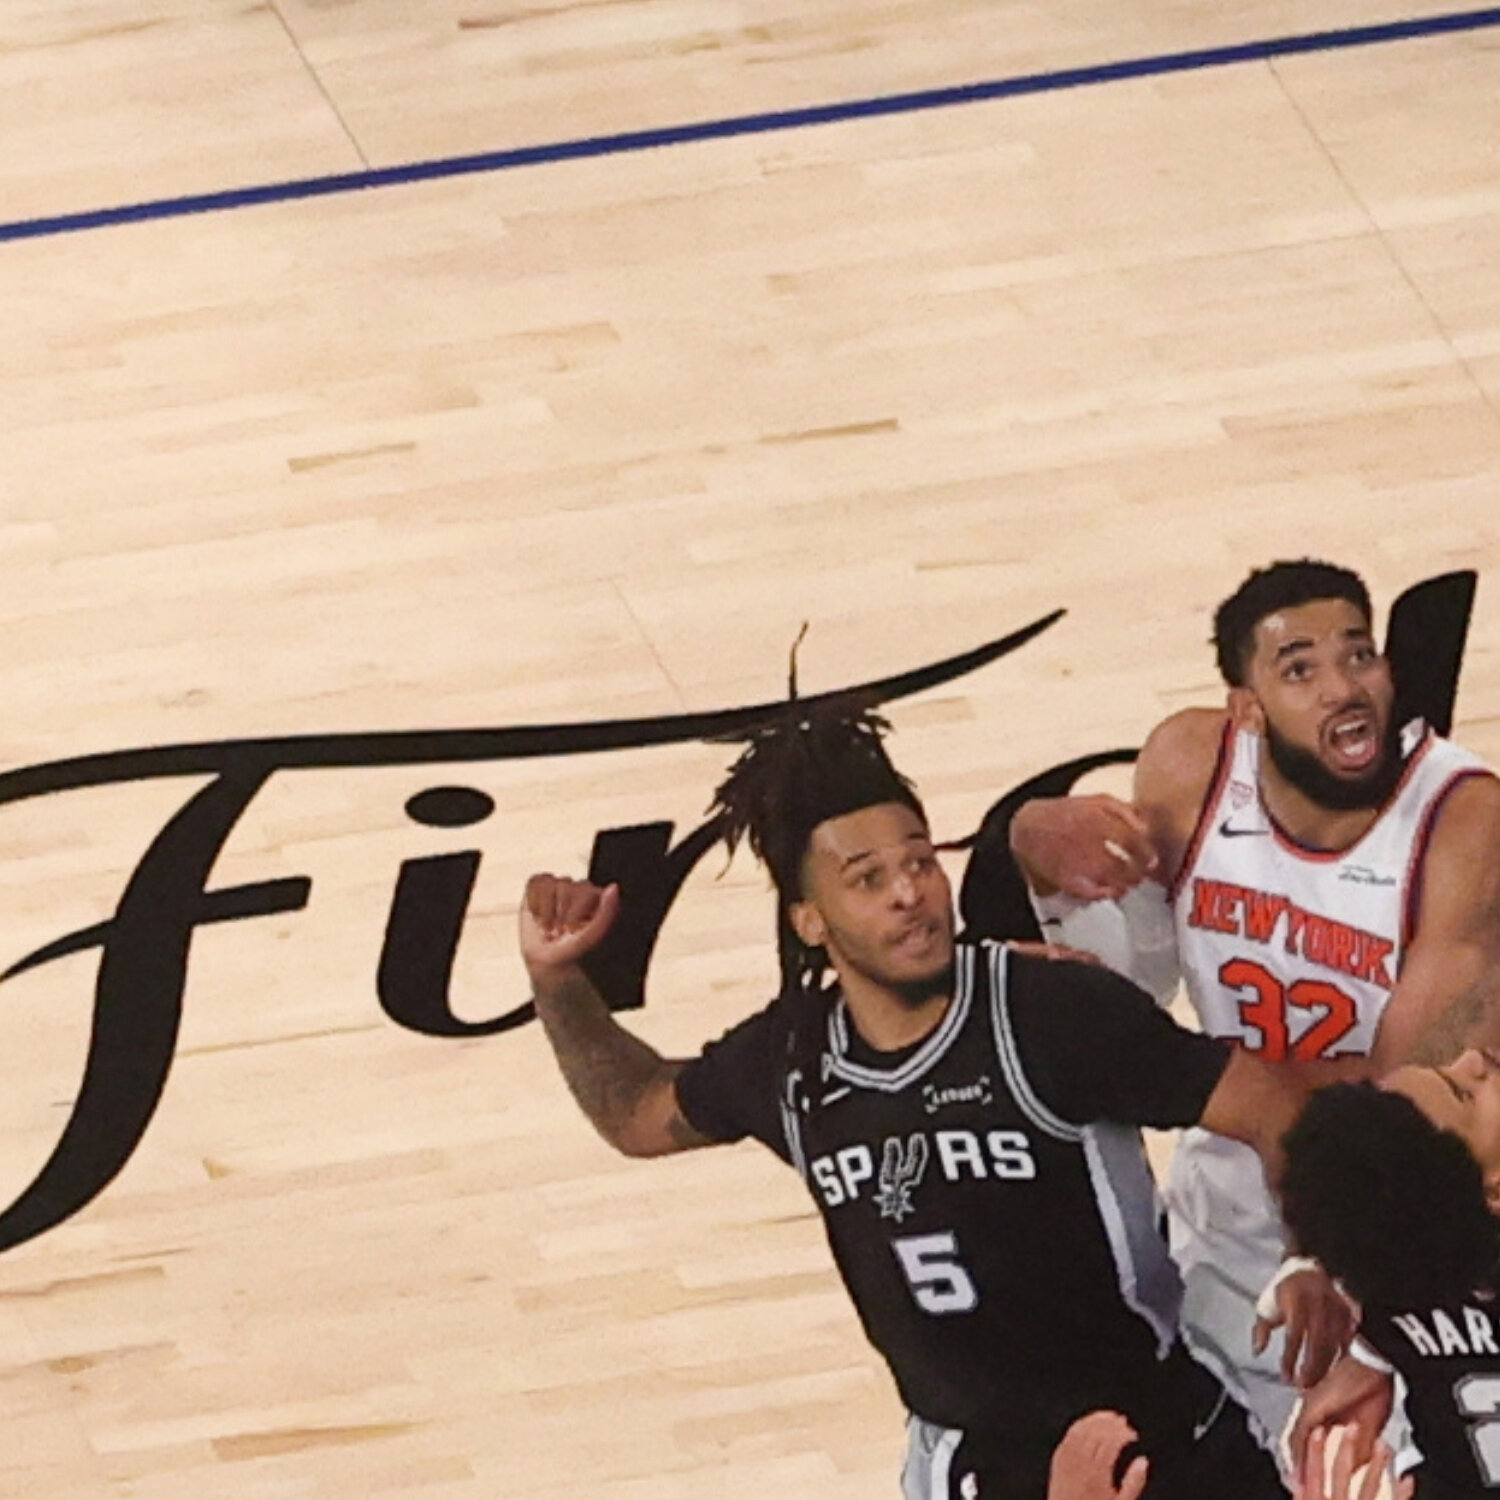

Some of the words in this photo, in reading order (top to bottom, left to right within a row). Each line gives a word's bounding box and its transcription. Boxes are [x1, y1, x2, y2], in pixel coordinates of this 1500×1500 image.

[1187, 877, 1290, 944] NEW
[1285, 902, 1394, 990] YORK
[1214, 956, 1367, 1062] 32
[892, 1230, 978, 1316] 5
